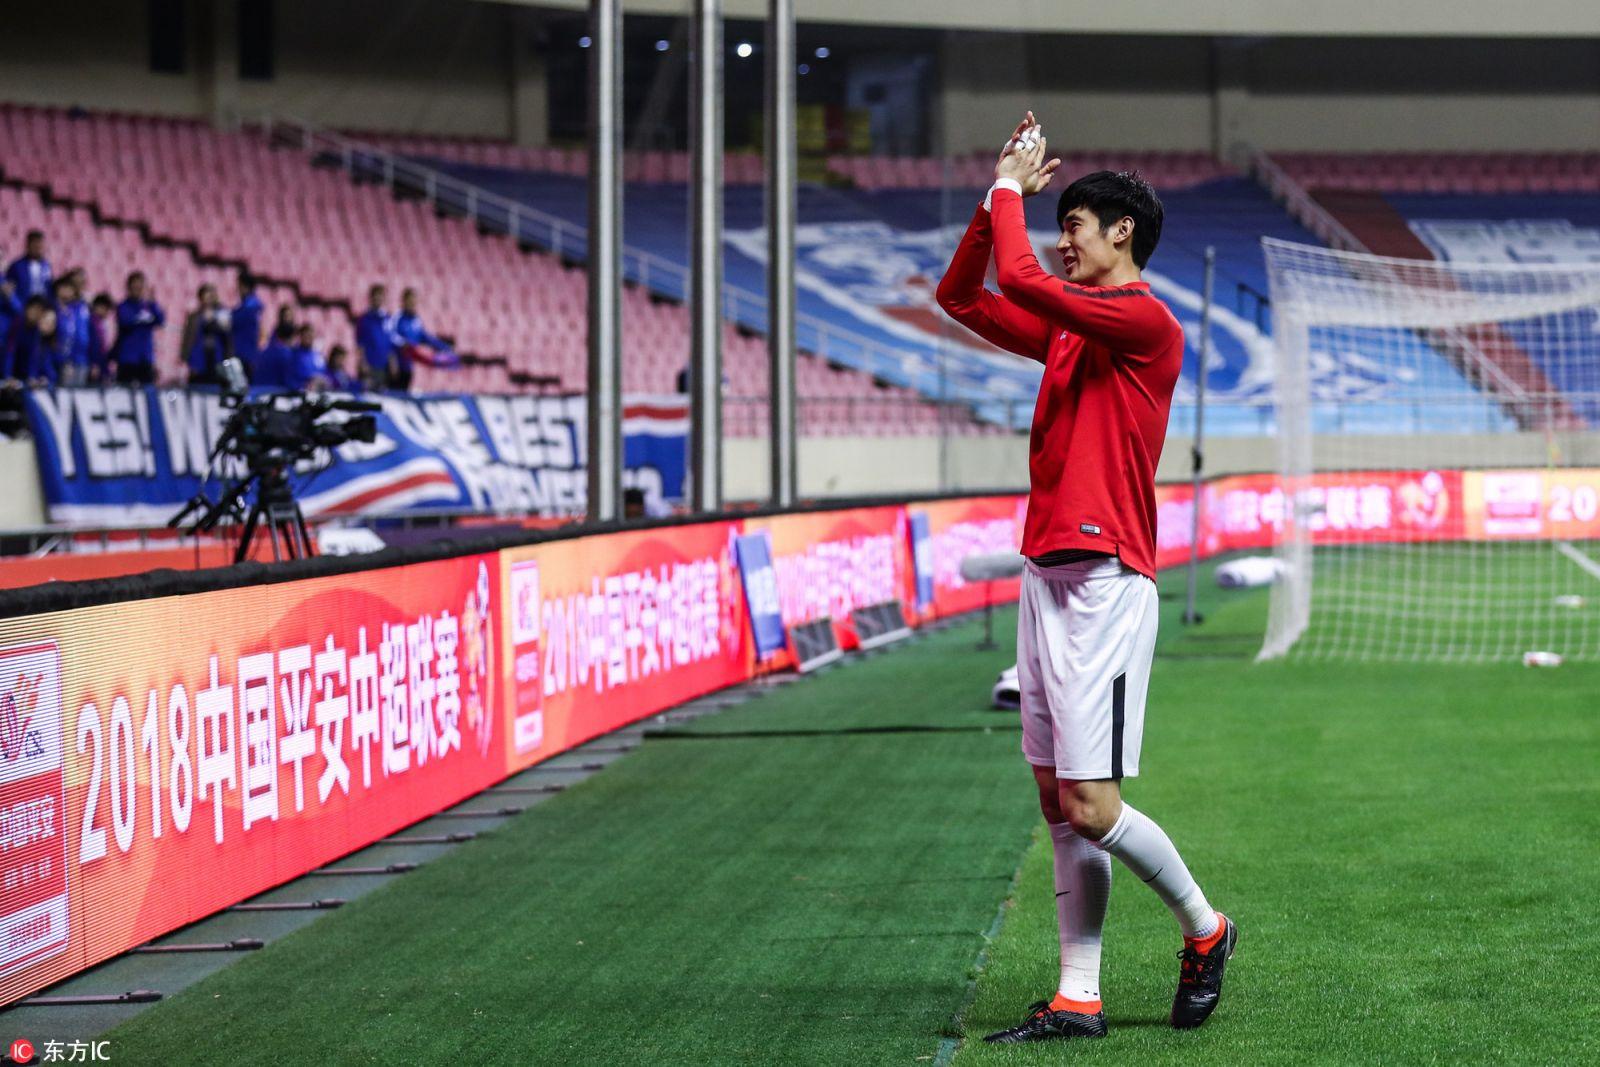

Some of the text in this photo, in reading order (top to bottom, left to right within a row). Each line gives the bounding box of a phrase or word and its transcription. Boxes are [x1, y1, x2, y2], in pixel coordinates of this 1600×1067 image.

[32, 387, 157, 478] YES!
[477, 395, 588, 470] BEST
[76, 609, 462, 865] 2018中国平安中超联赛
